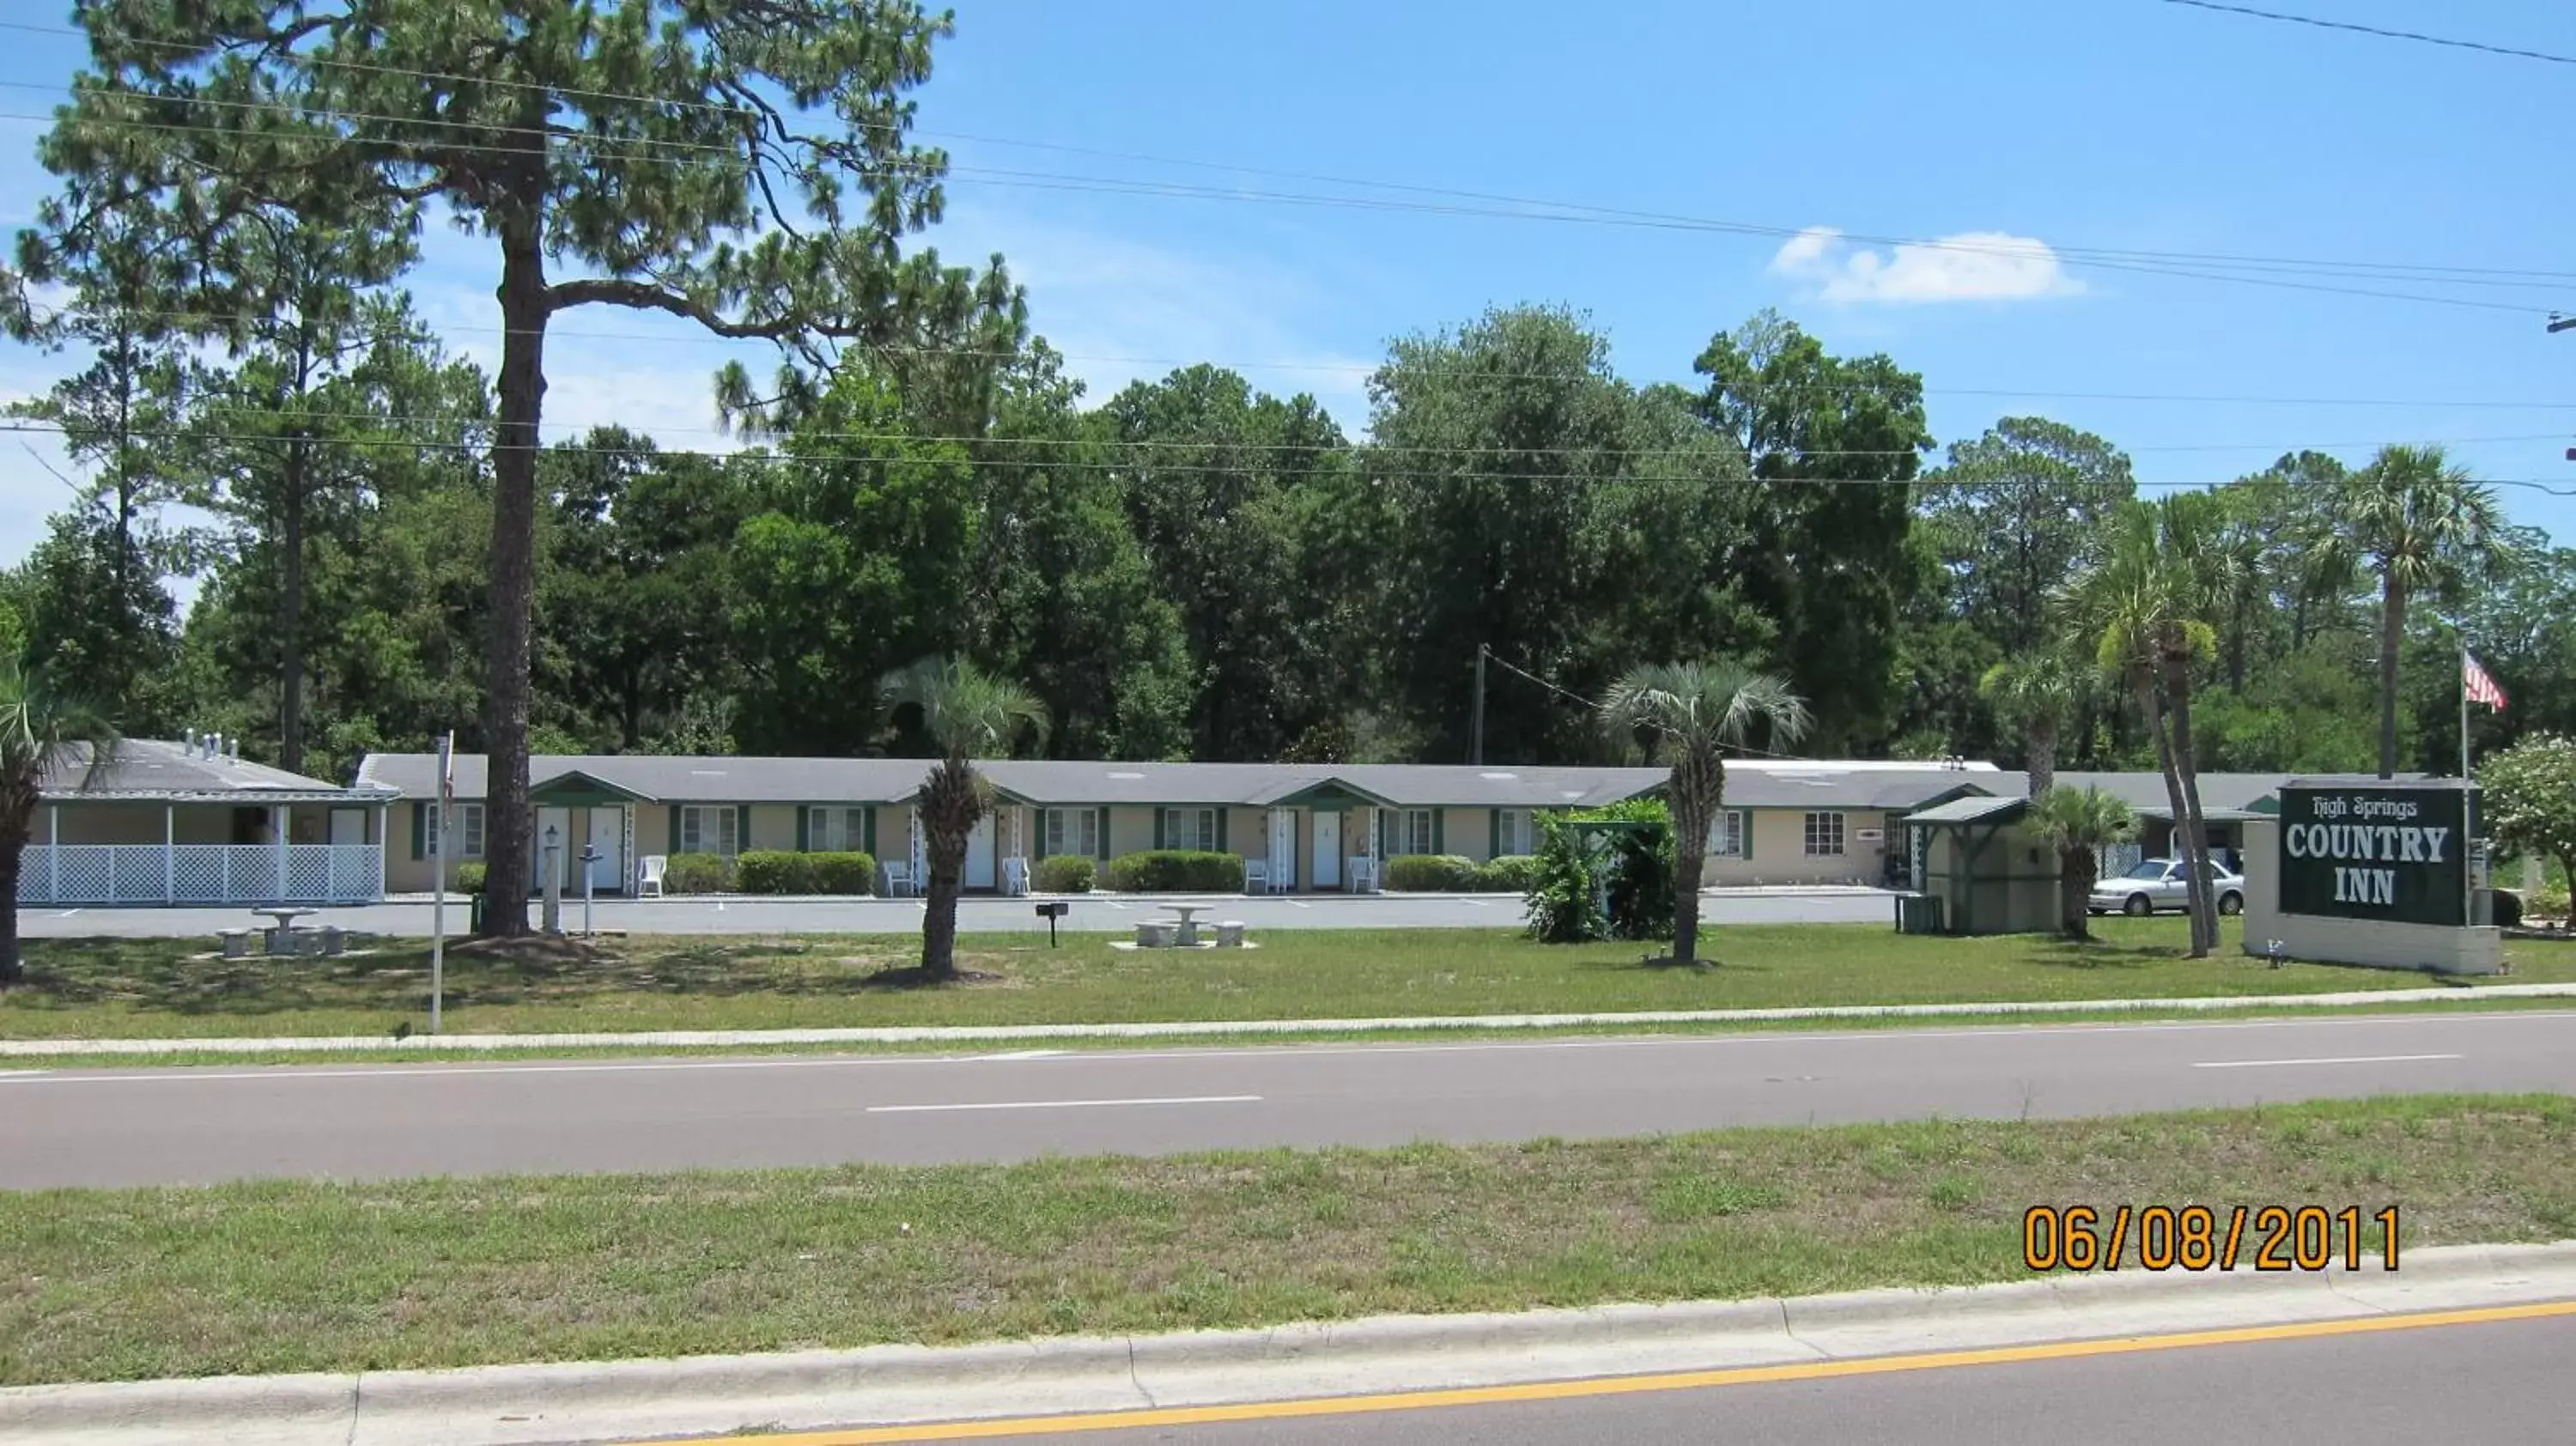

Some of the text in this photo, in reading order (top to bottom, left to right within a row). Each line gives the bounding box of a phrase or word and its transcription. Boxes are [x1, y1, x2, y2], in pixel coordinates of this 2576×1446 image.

[2353, 797, 2418, 820] Springs
[2287, 823, 2448, 863] COUNTRY
[2335, 866, 2395, 904] INN
